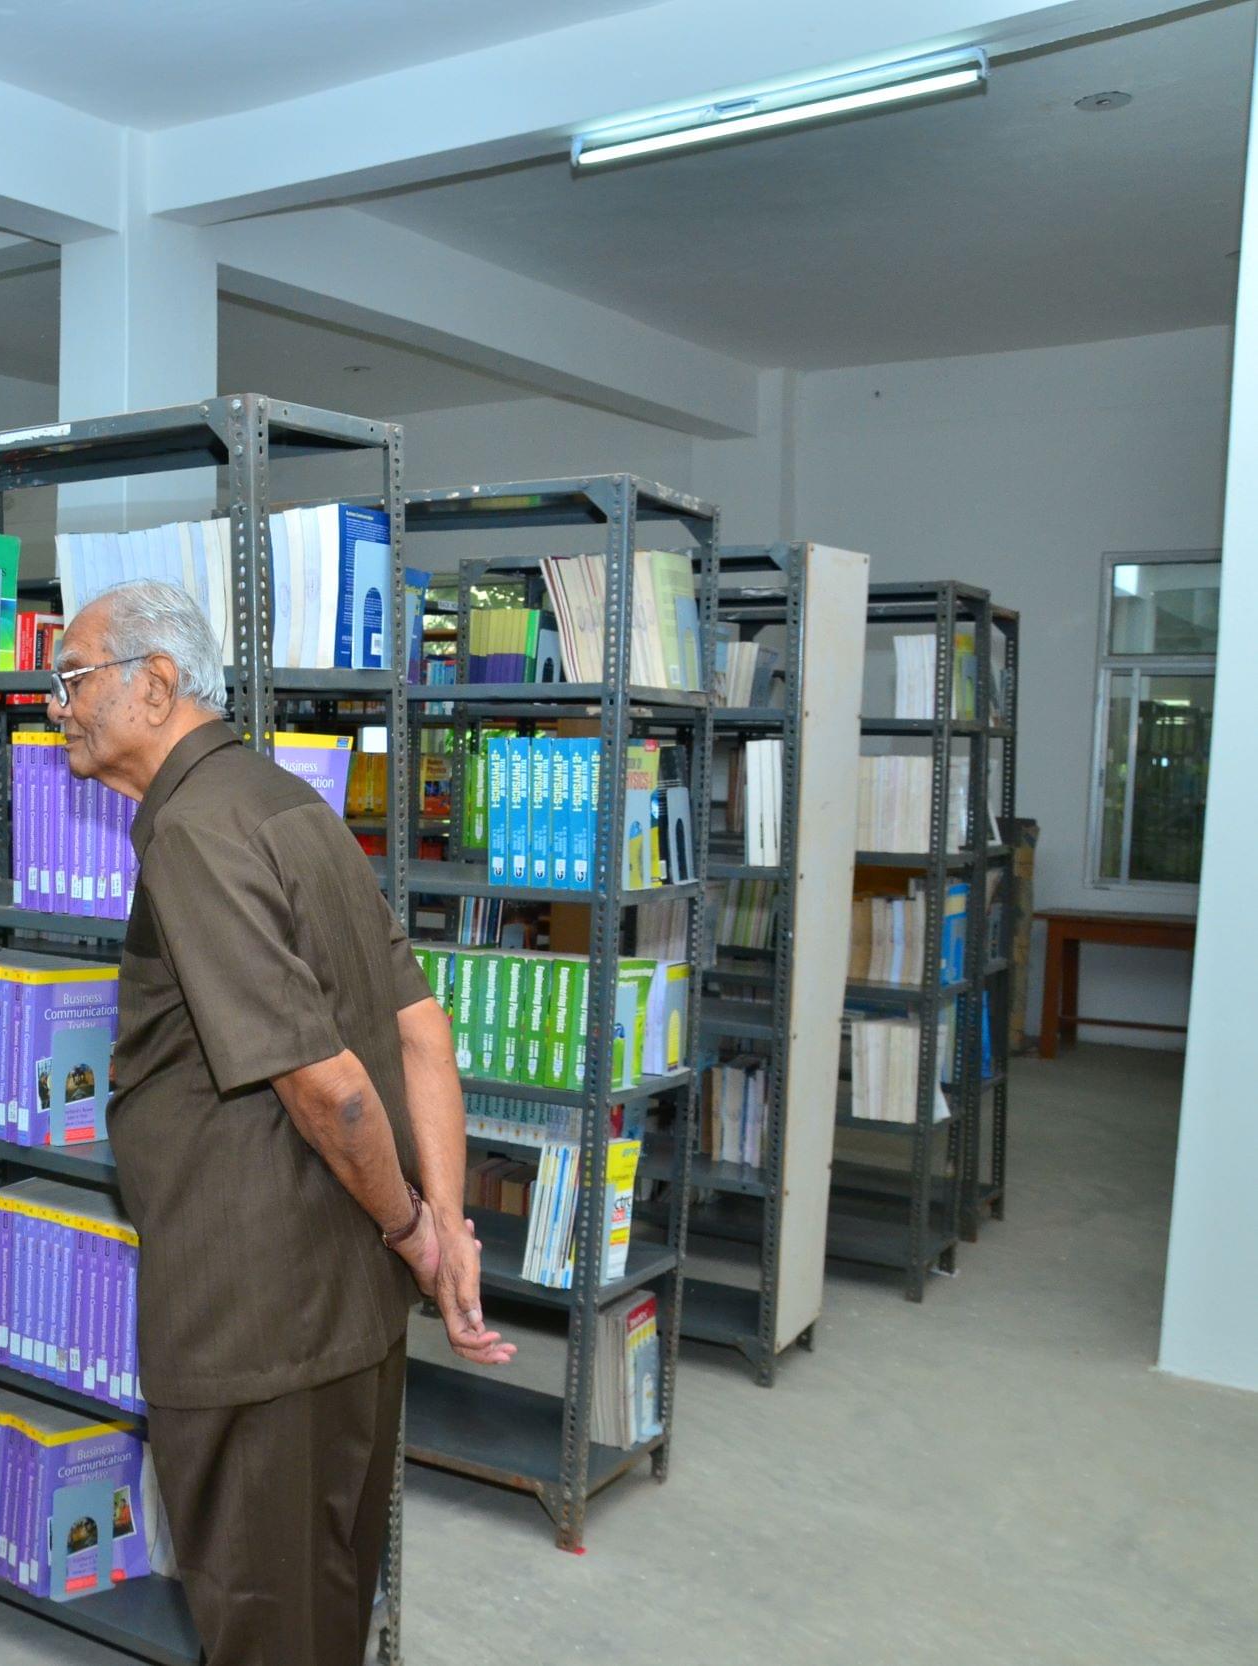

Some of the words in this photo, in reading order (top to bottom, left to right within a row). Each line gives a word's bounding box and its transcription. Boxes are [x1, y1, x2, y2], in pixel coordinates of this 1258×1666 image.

[280, 759, 318, 772] Business
[460, 960, 473, 998] Engineering
[486, 960, 498, 998] Engineering
[509, 963, 520, 1002] Engineering
[532, 965, 545, 1005] Engineering
[557, 967, 570, 1007] Engineering
[63, 992, 102, 1005] Business
[460, 999, 471, 1024] Physics
[44, 1004, 118, 1021] Communication
[485, 1000, 496, 1025] Physics
[507, 1003, 518, 1028] Physics
[531, 1005, 542, 1031] Physics
[555, 1007, 567, 1033] Physics
[23, 1033, 31, 1086] Communication
[57, 1451, 132, 1479] Communication
[77, 1443, 115, 1461] Business
